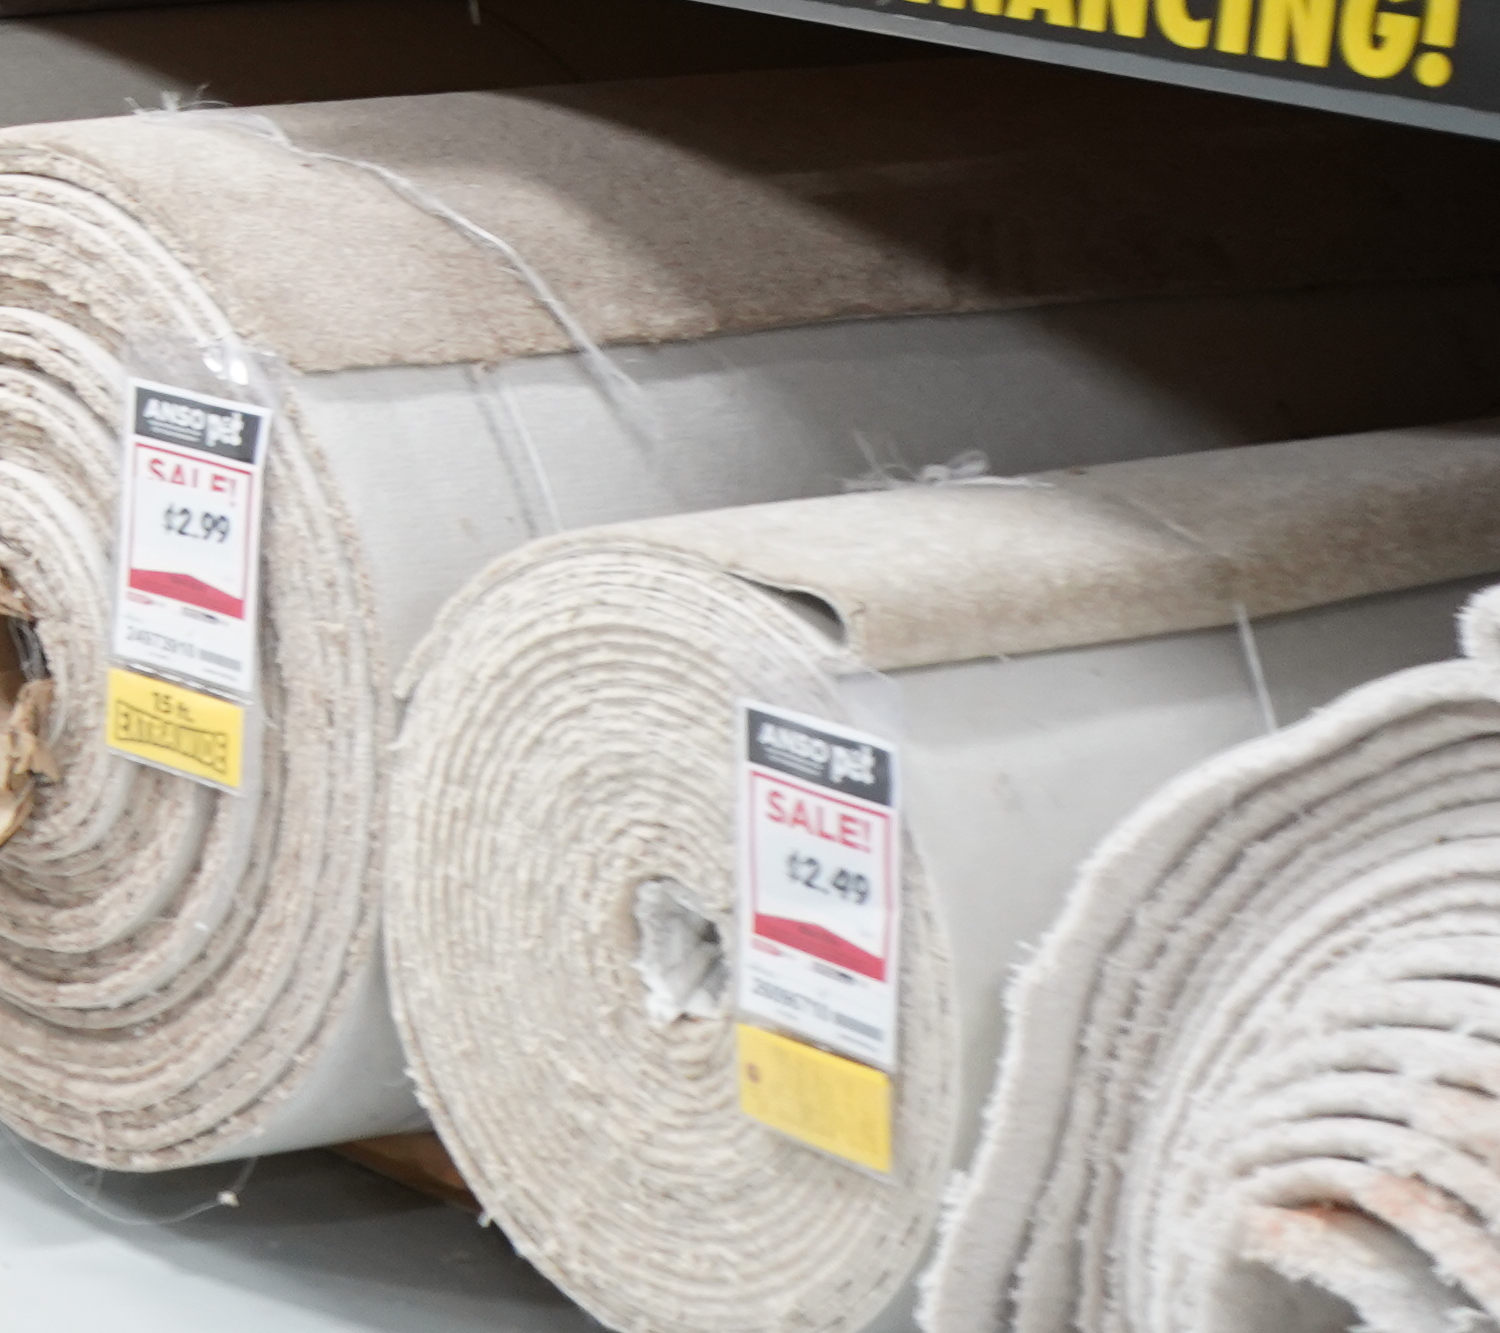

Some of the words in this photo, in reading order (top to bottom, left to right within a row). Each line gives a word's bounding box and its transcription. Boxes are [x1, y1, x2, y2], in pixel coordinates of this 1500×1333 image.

[163, 501, 230, 544] $2.99
[765, 789, 873, 853] SALE!
[786, 852, 871, 907] $2.49
